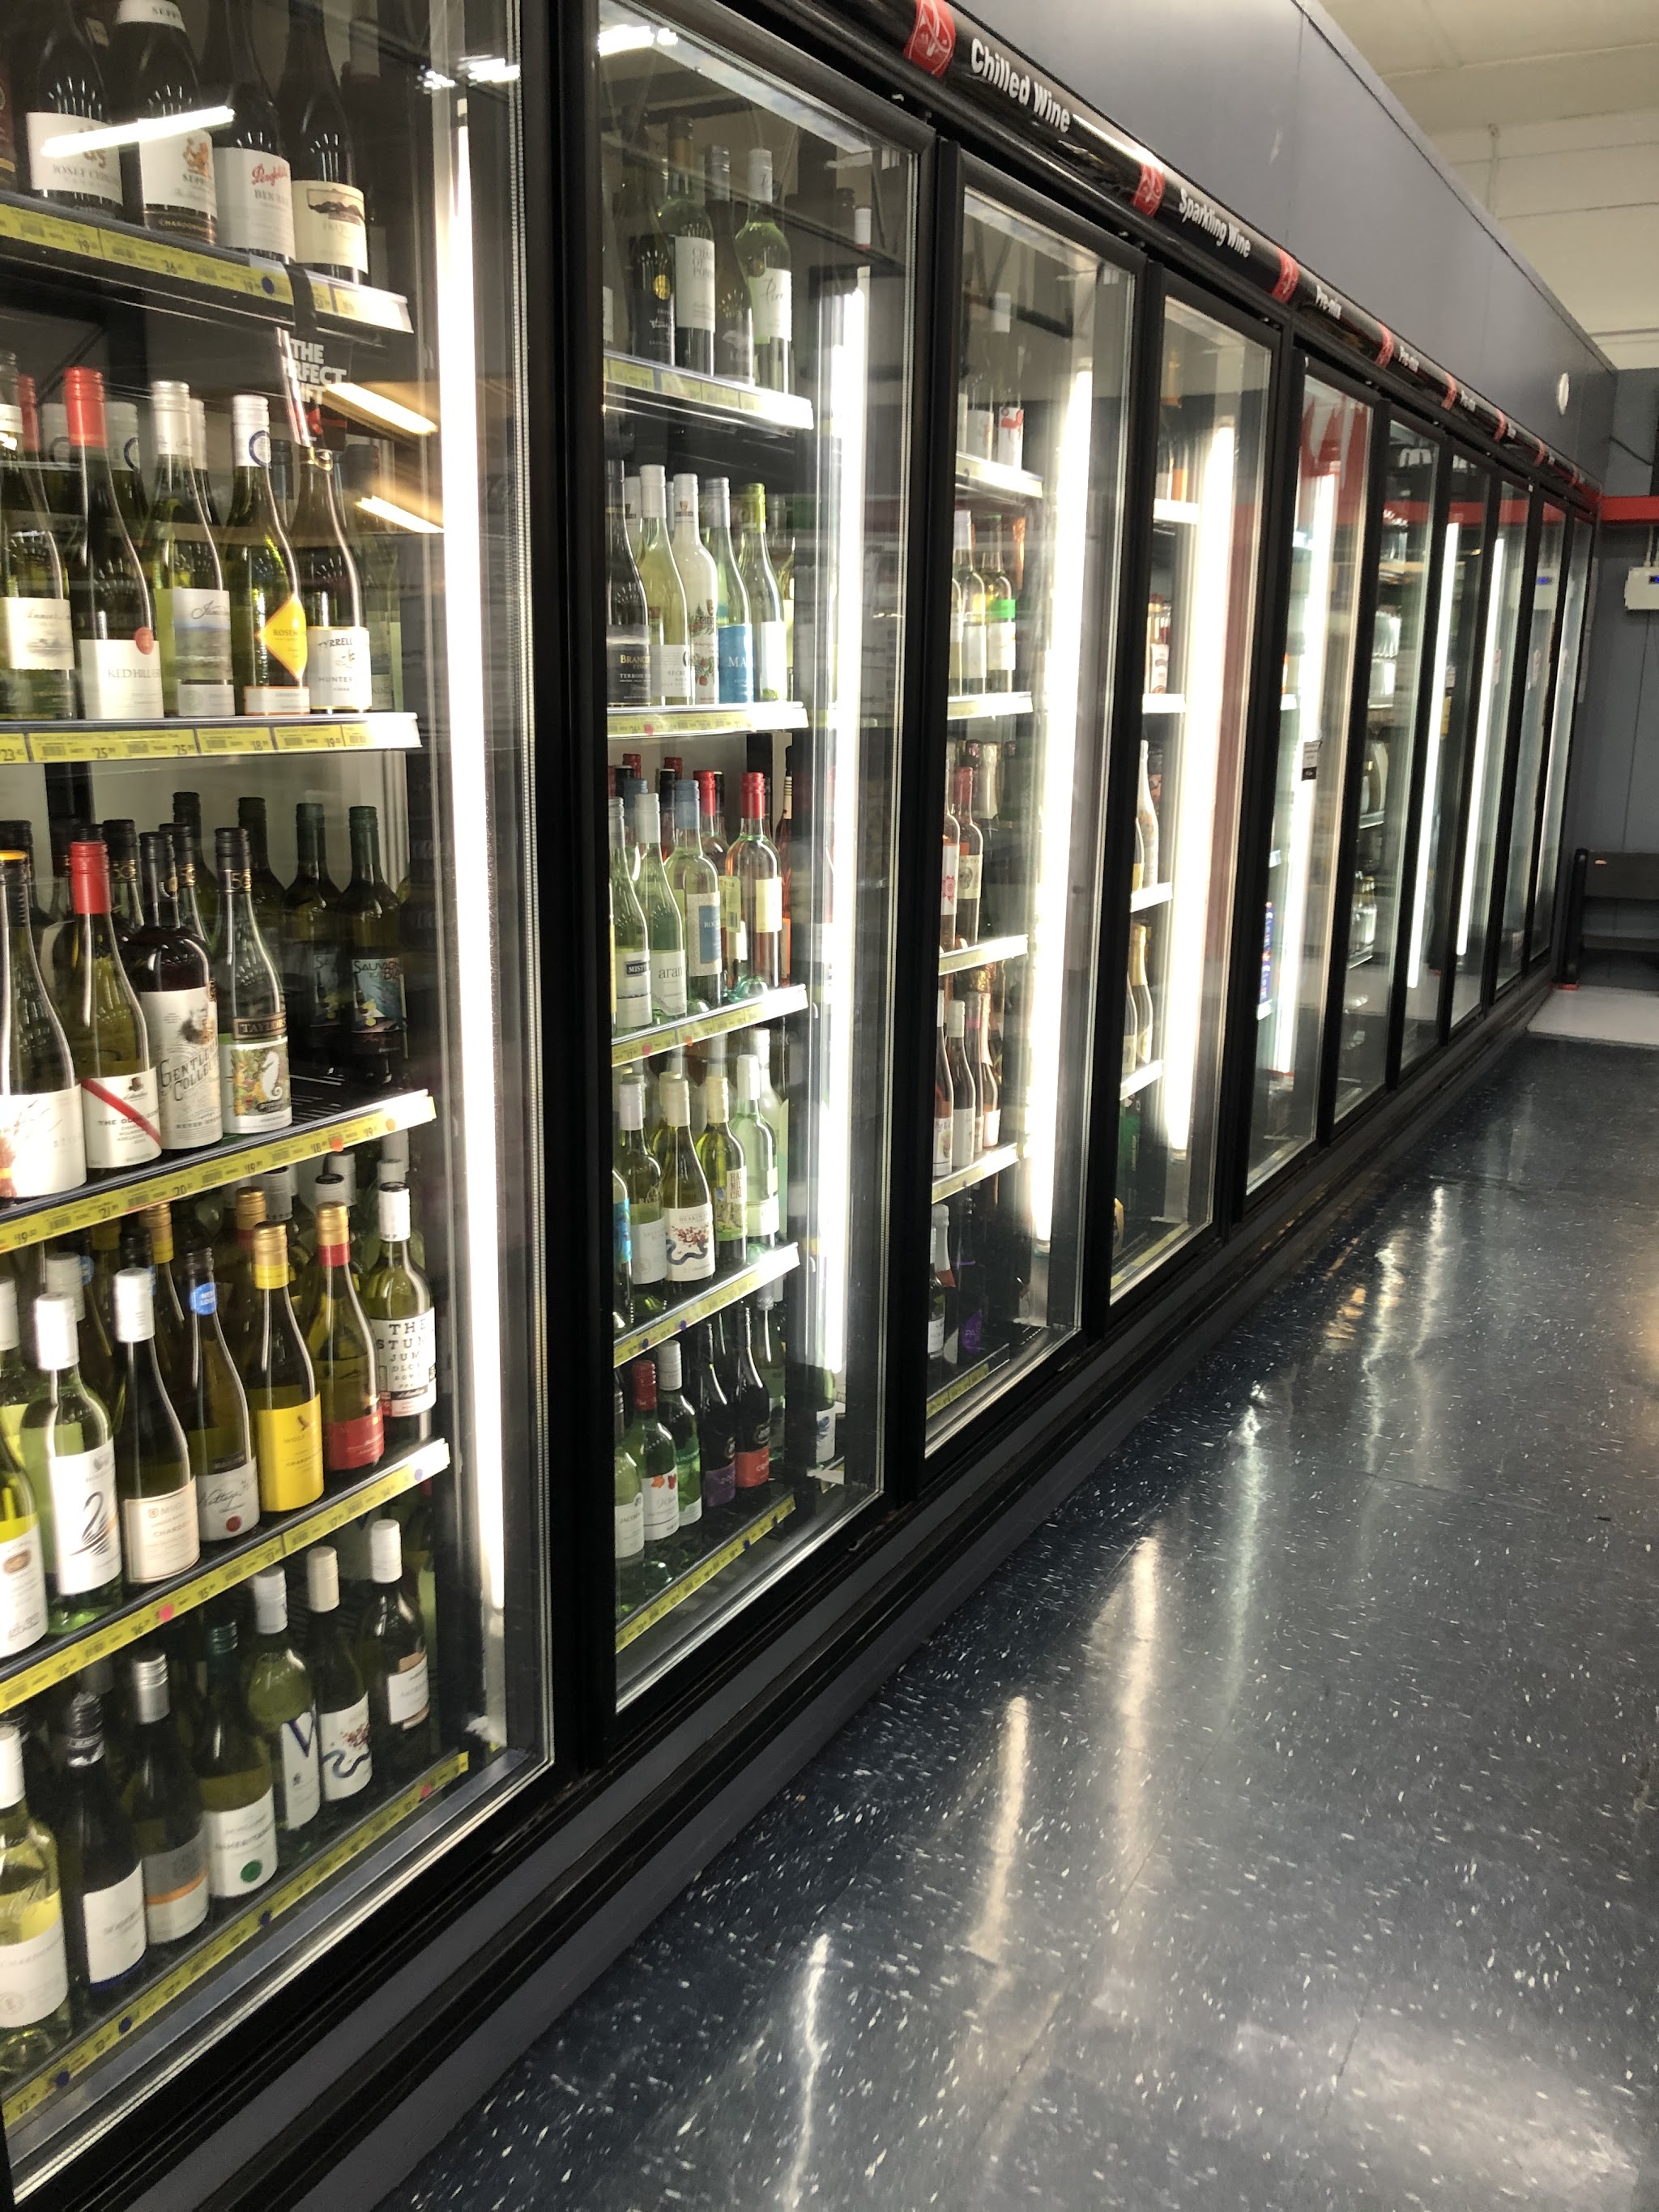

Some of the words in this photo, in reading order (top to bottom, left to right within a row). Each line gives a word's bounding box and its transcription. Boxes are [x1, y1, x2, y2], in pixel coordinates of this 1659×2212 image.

[971, 38, 1030, 106] Chilled
[1034, 82, 1070, 133] Wine
[1179, 188, 1227, 246] Sparkling
[1227, 223, 1251, 258] Wine
[291, 339, 324, 364] THE
[300, 382, 326, 405] IFT
[389, 1318, 427, 1336] THE
[377, 1336, 424, 1350] STU
[390, 1351, 420, 1362] JUM
